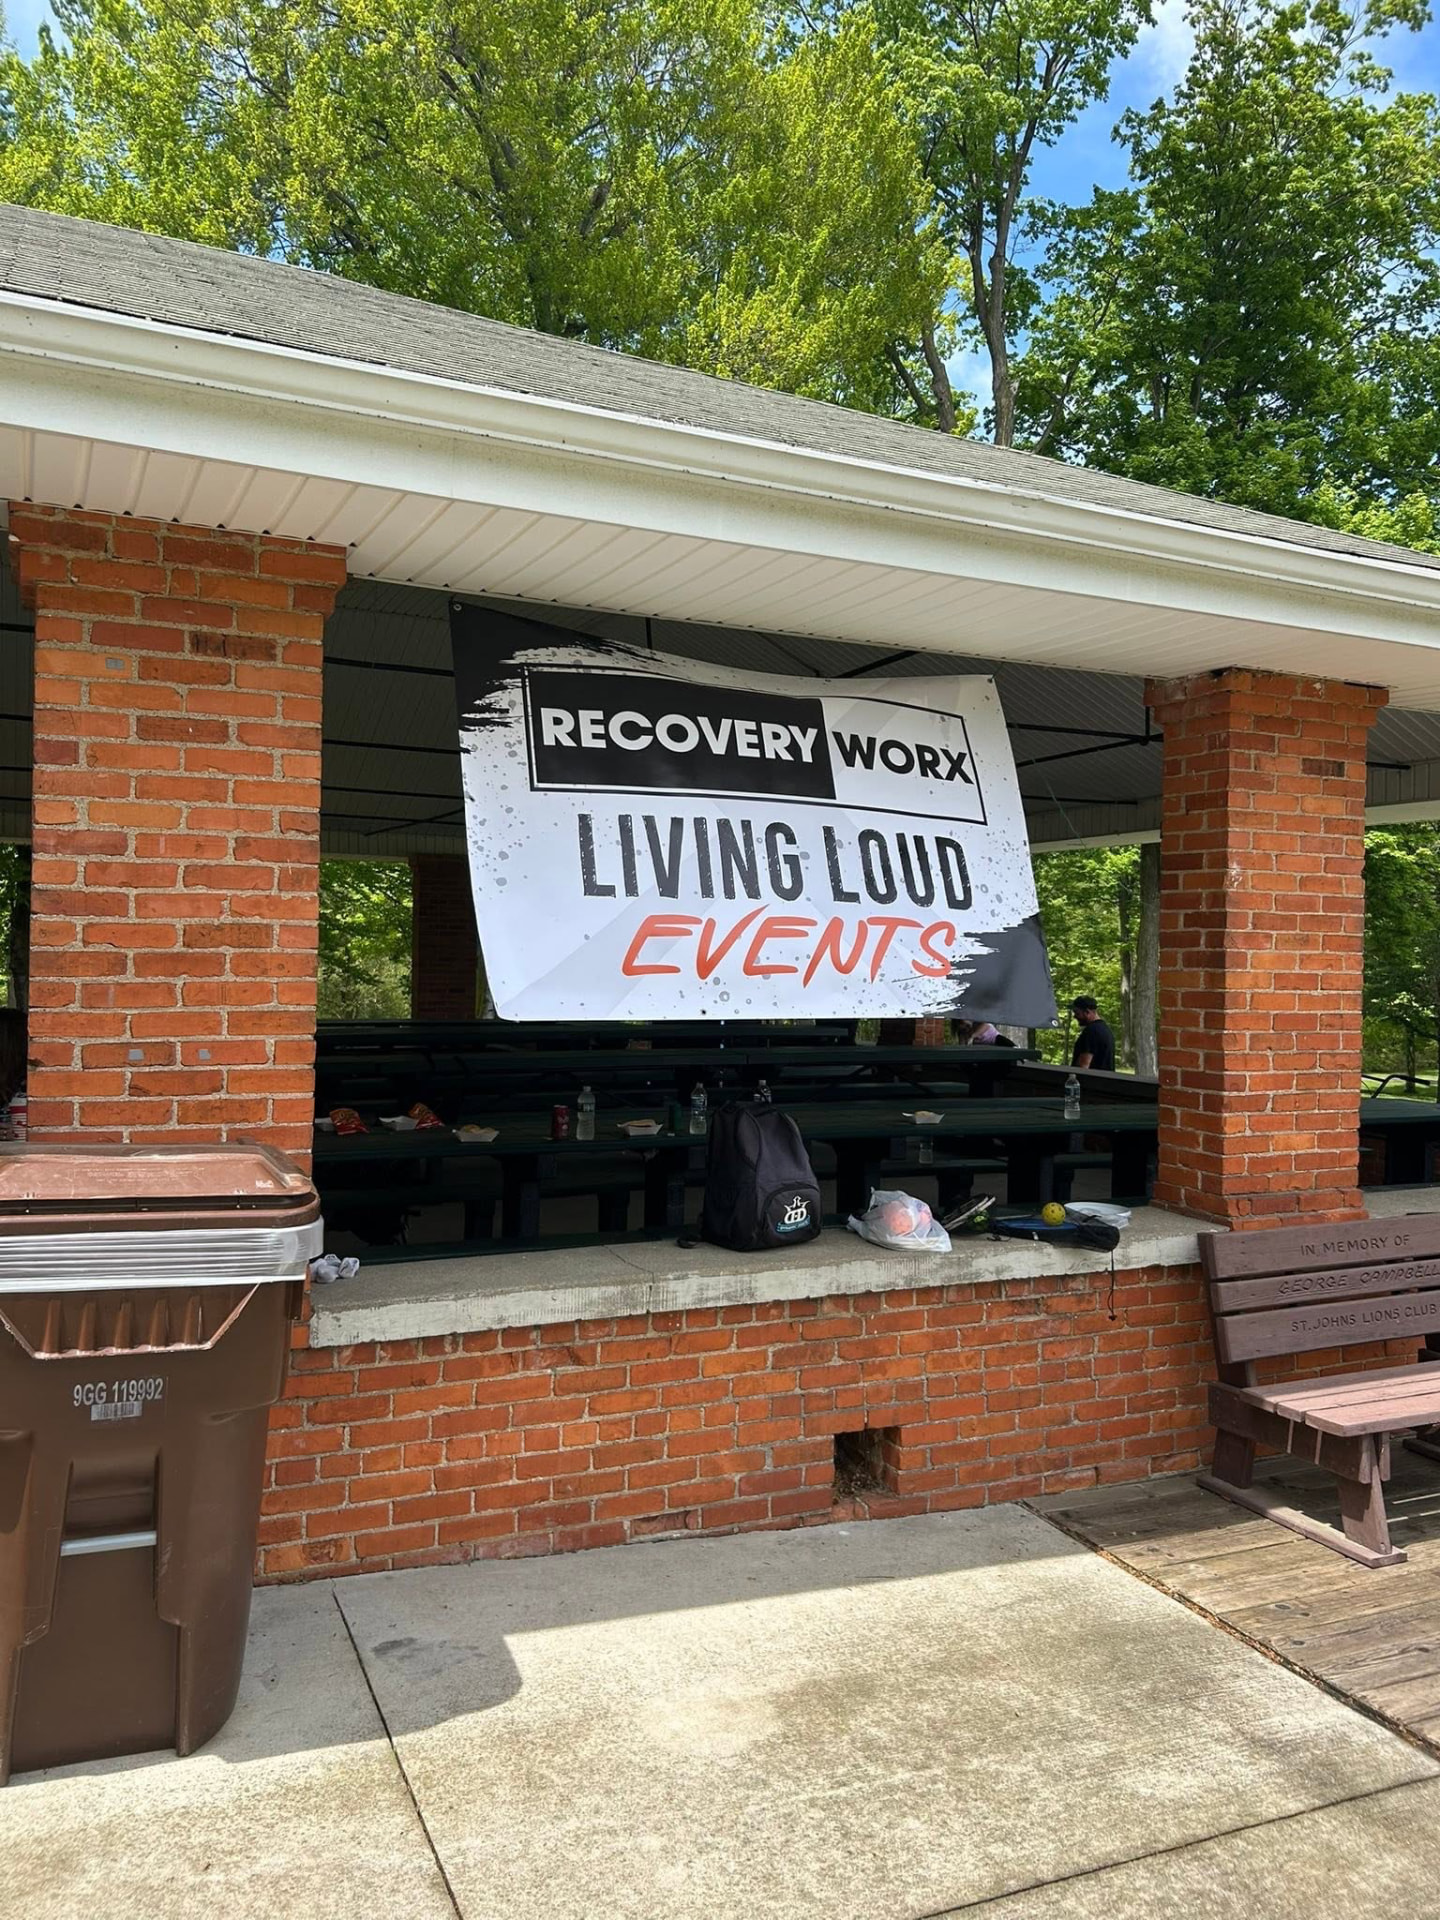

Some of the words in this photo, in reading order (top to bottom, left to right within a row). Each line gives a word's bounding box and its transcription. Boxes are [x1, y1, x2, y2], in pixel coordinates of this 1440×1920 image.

[540, 706, 819, 763] RECOVERY
[832, 731, 975, 784] WORX
[577, 813, 803, 901] LIVING
[822, 825, 973, 910] LOUD
[622, 903, 956, 988] EVENTS
[1300, 1244, 1316, 1256] IN
[1323, 1236, 1389, 1254] MEMORY
[1394, 1234, 1411, 1247] OF
[1278, 1274, 1348, 1295] GEORGE
[1359, 1263, 1440, 1284] CAMPBELL
[1362, 1308, 1400, 1323] LIONS
[1404, 1303, 1437, 1318] CLUB
[73, 1382, 107, 1407] 9GG
[112, 1378, 164, 1403] 119992
